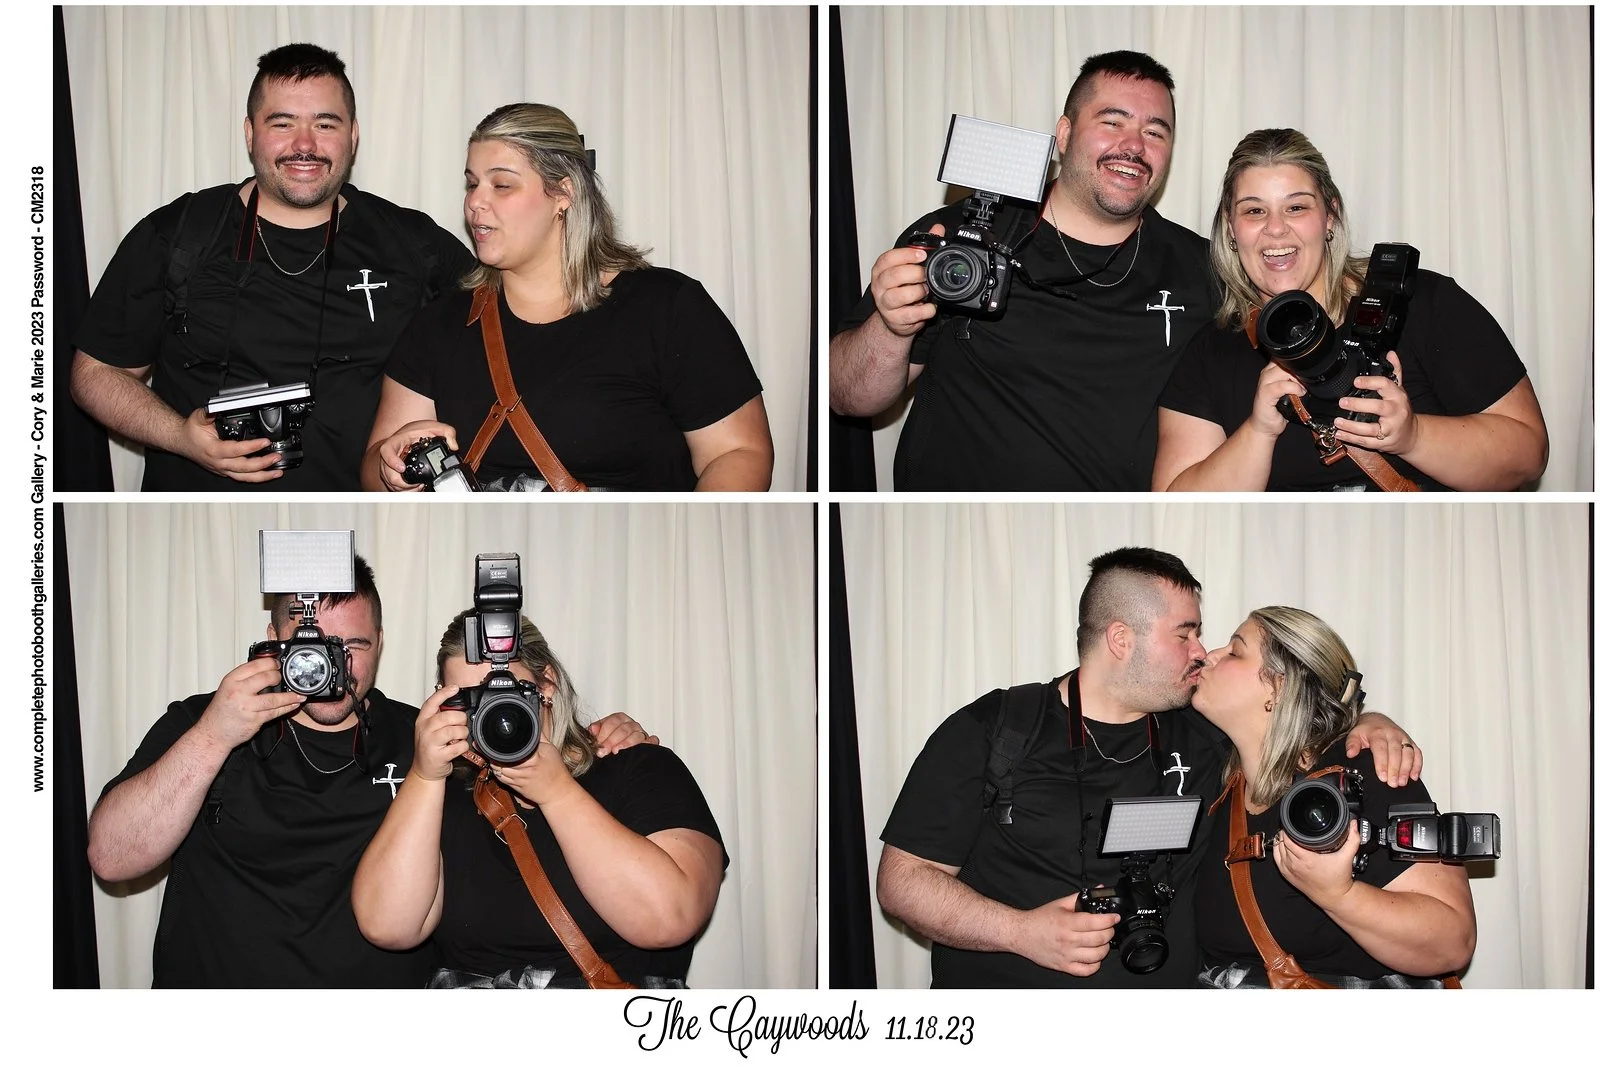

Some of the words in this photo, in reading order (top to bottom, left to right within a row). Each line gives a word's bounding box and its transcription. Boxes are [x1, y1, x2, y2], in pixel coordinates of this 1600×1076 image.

[957, 230, 982, 242] Nikon
[490, 679, 513, 687] Nikon
[1361, 819, 1369, 842] Nikon
